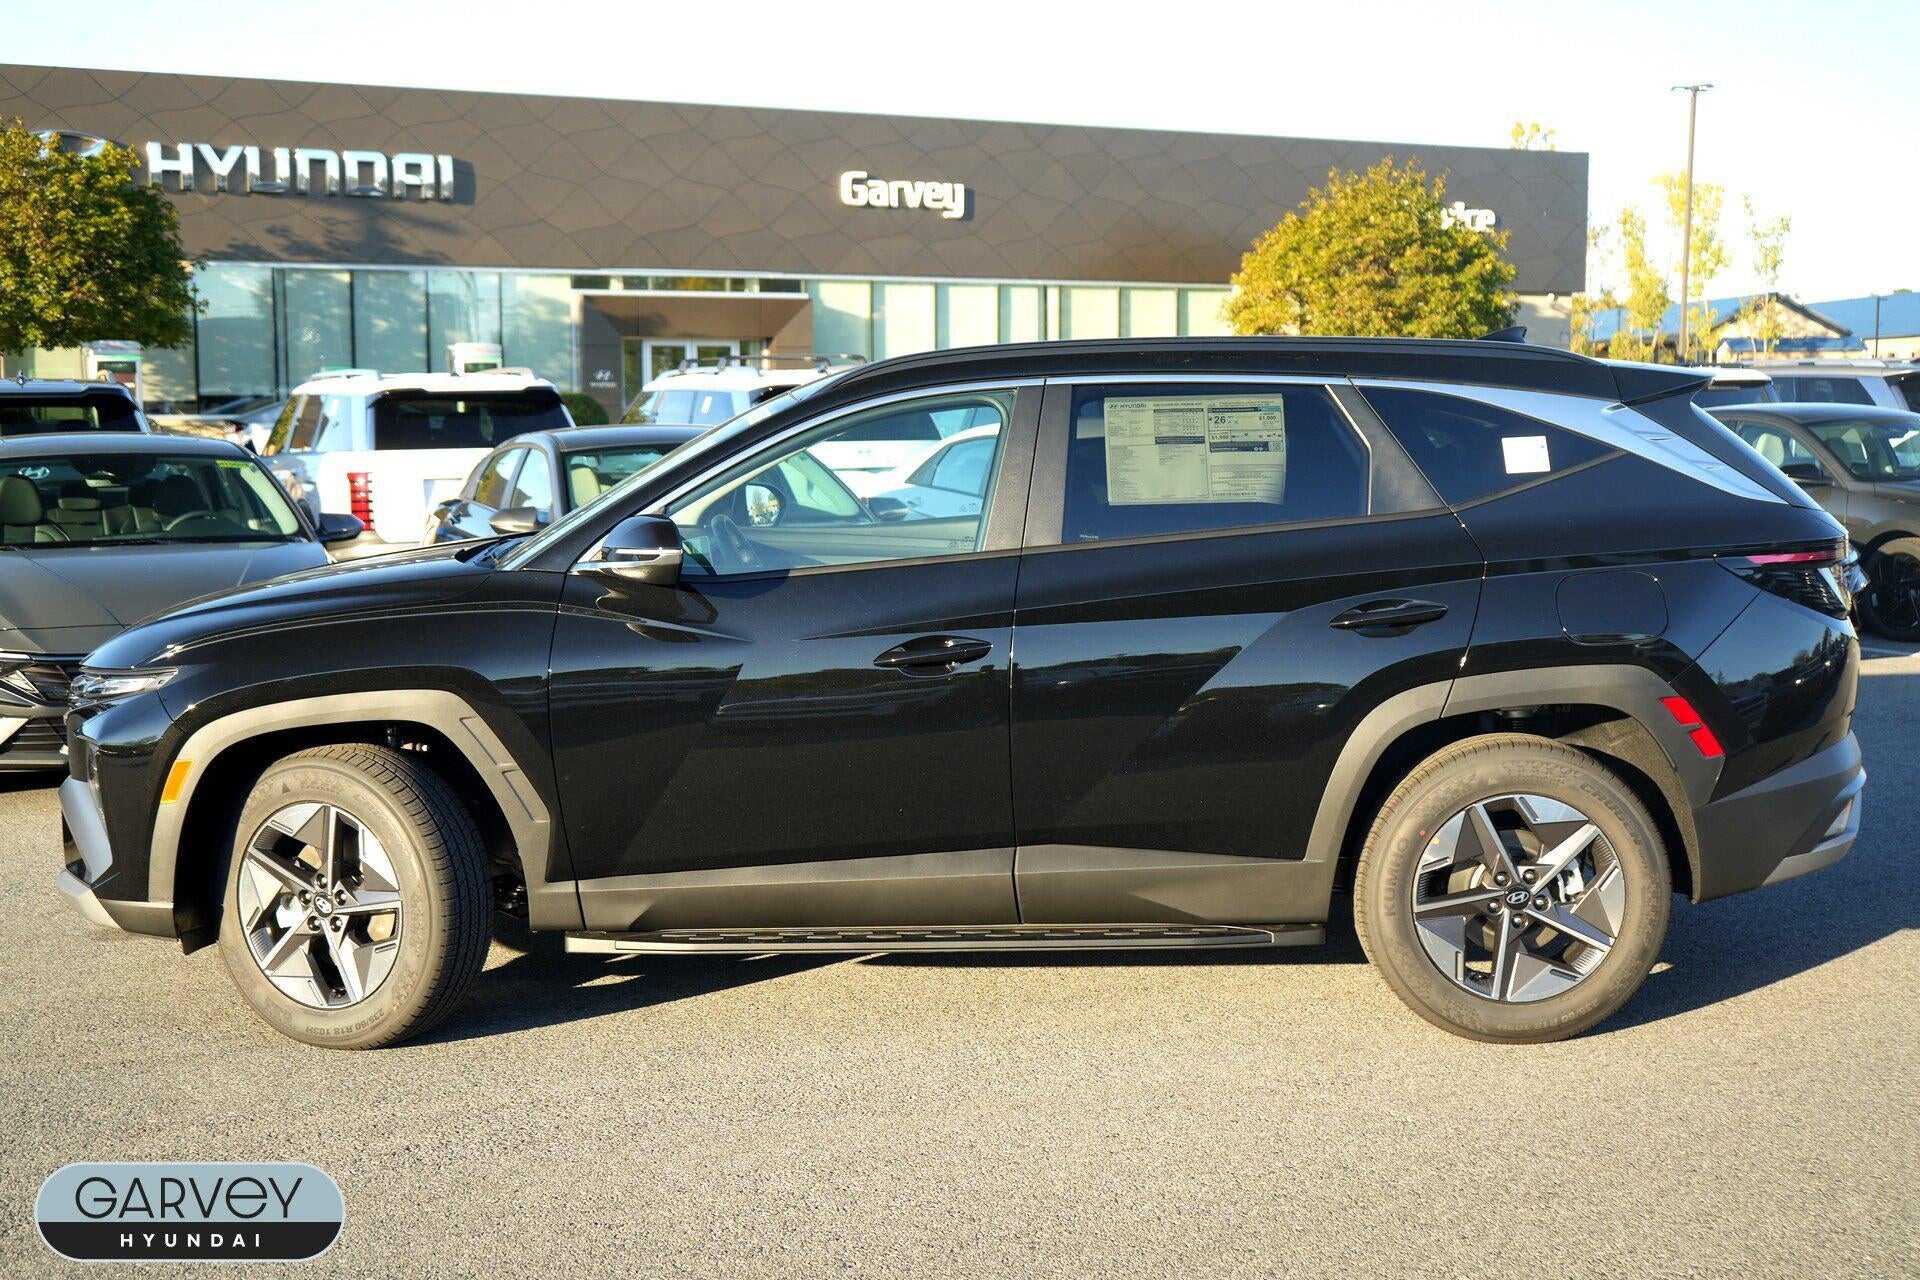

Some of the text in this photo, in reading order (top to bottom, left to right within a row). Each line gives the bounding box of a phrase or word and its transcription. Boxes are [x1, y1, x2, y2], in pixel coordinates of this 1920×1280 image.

[146, 141, 454, 200] HYUNDAI
[840, 170, 966, 219] Garvey
[1214, 416, 1226, 424] 26
[1384, 837, 1410, 916] KUMHO
[305, 1008, 385, 1036] 235/60 R18 103H
